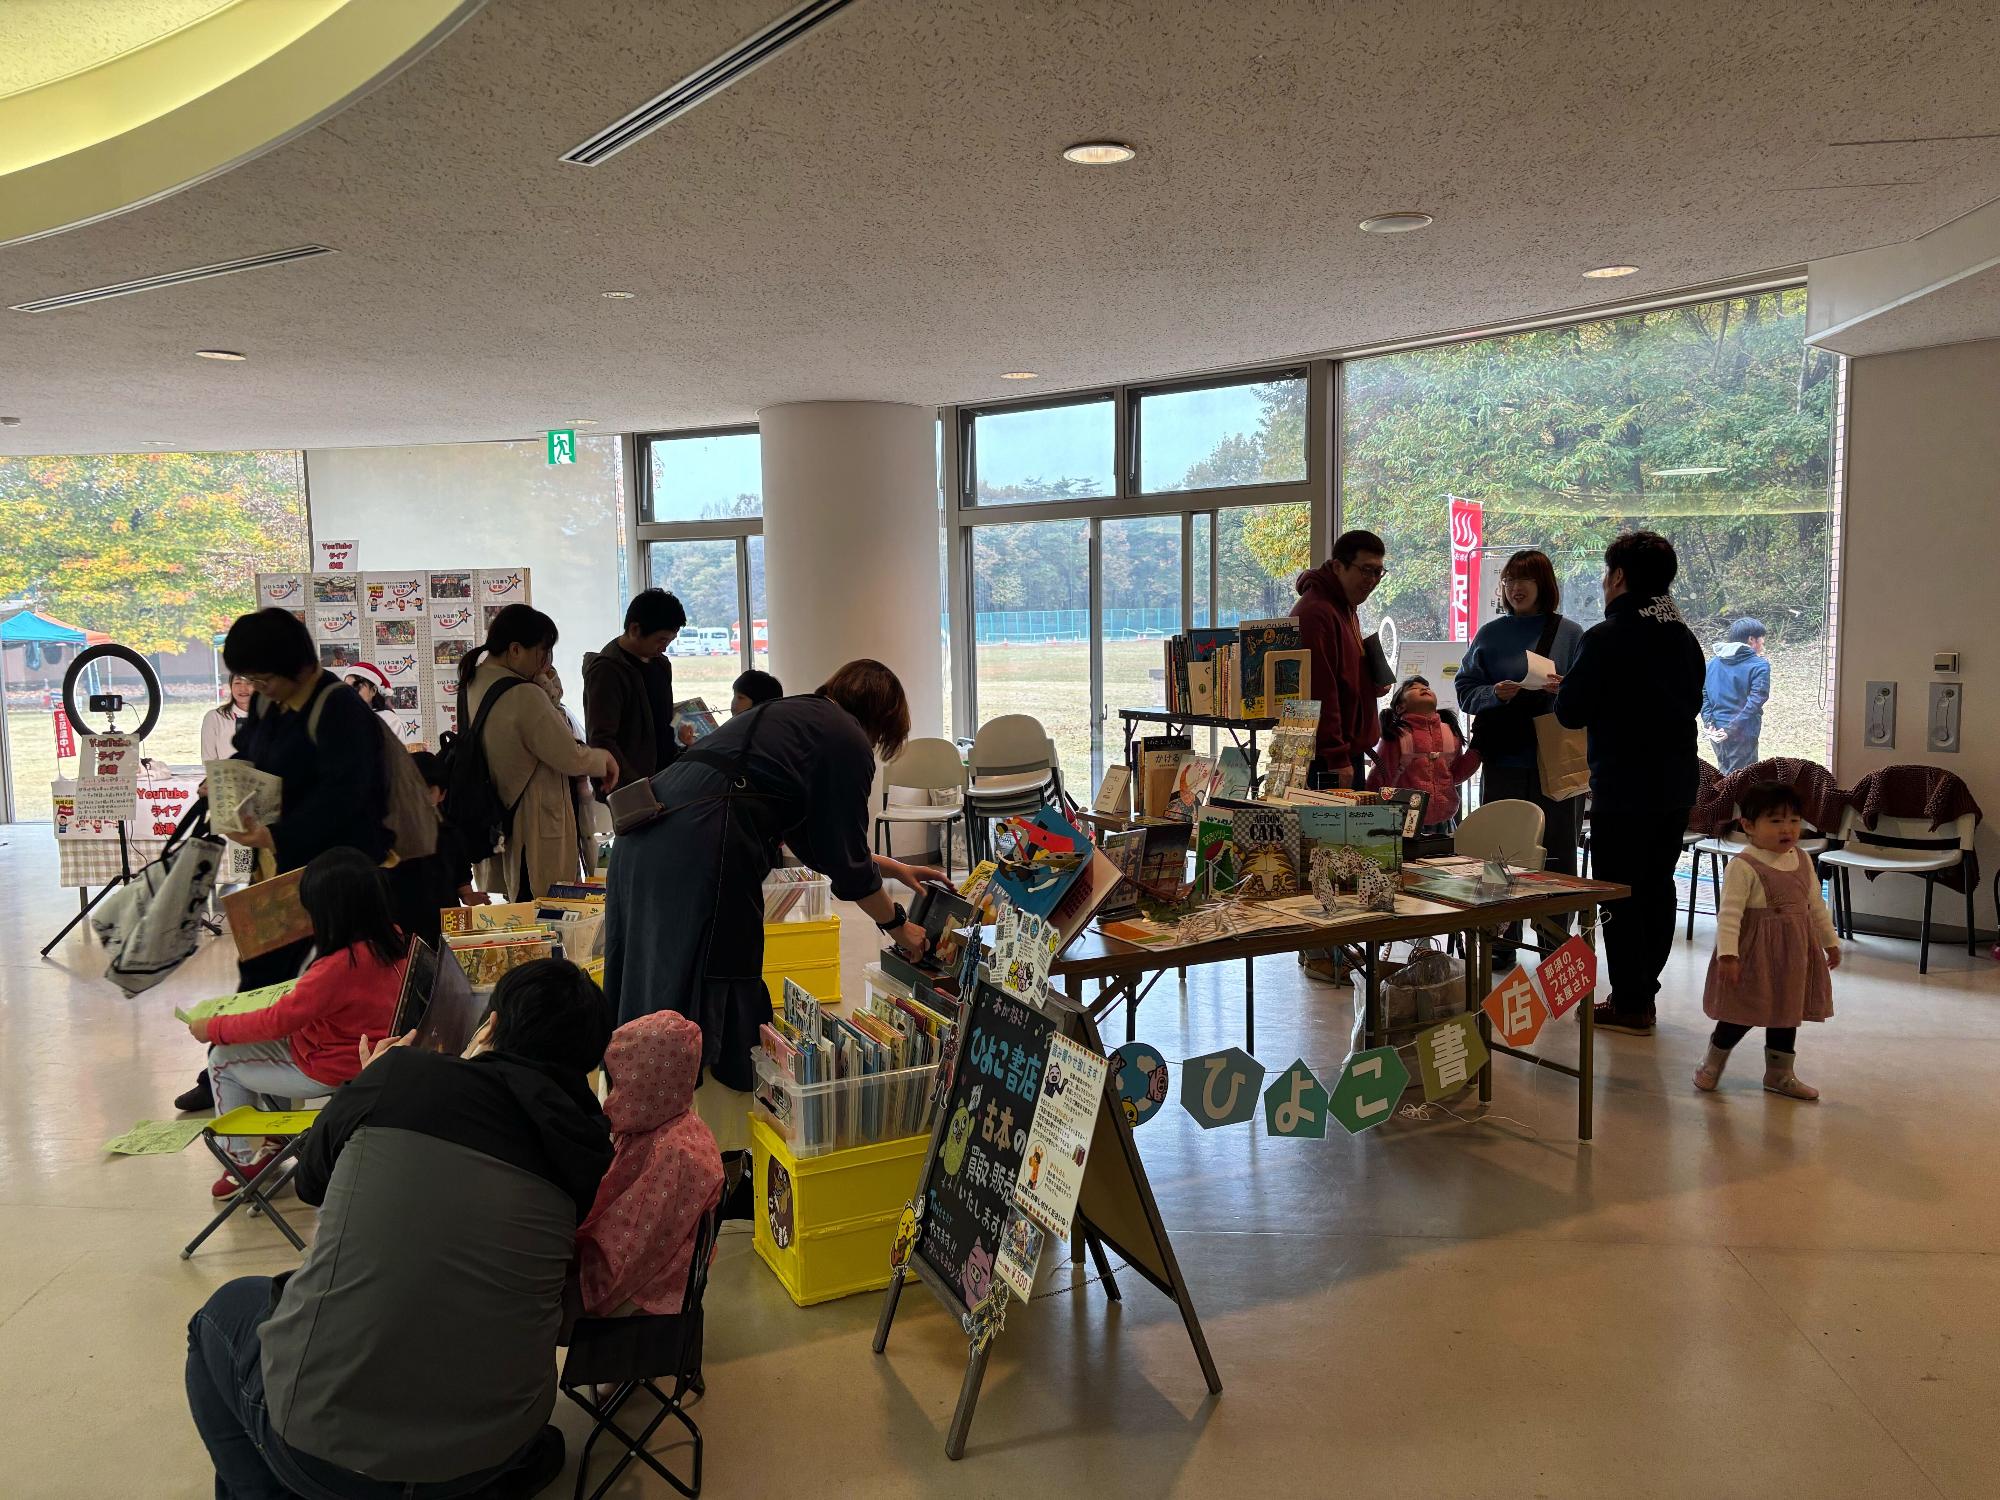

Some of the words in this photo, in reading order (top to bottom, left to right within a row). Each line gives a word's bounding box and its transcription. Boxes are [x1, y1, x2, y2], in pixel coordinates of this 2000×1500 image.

[1155, 753, 1180, 764] かける
[137, 788, 189, 800] YouTube
[151, 804, 183, 817] ライブ
[1249, 823, 1285, 842] CATS
[1544, 951, 1572, 979] 那須の
[1549, 957, 1586, 992] つながる
[1554, 974, 1591, 1006] 本屋さん
[970, 1026, 1042, 1103] ひよこ書店
[981, 1096, 1028, 1158] 古本の
